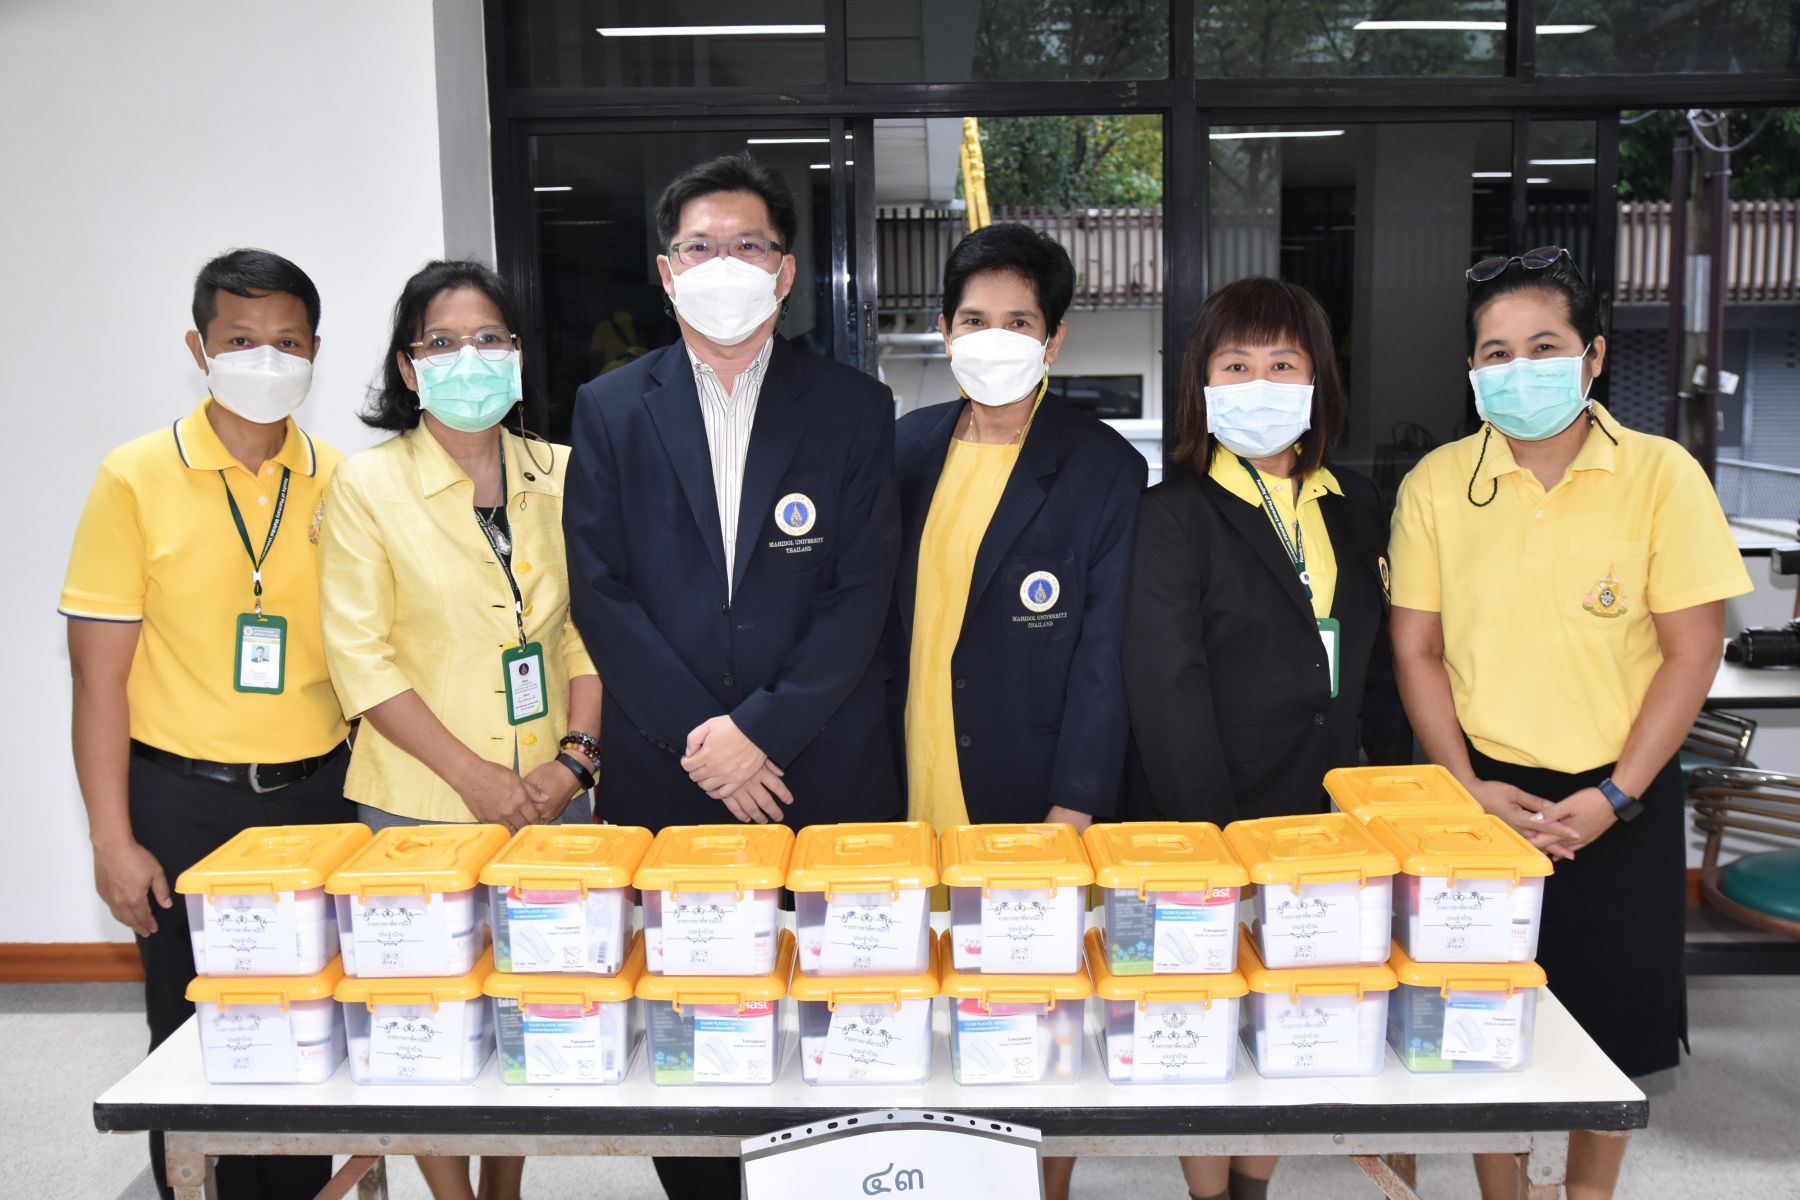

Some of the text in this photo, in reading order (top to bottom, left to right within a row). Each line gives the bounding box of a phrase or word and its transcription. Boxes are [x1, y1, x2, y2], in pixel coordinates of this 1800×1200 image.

[1256, 479, 1266, 494] Faculty
[768, 537, 824, 548] MAHIDOL UNIVERSITY
[786, 546, 812, 554] THAILAND
[1037, 612, 1068, 620] UNIVERSITY
[862, 1162, 924, 1196] ๔๓
